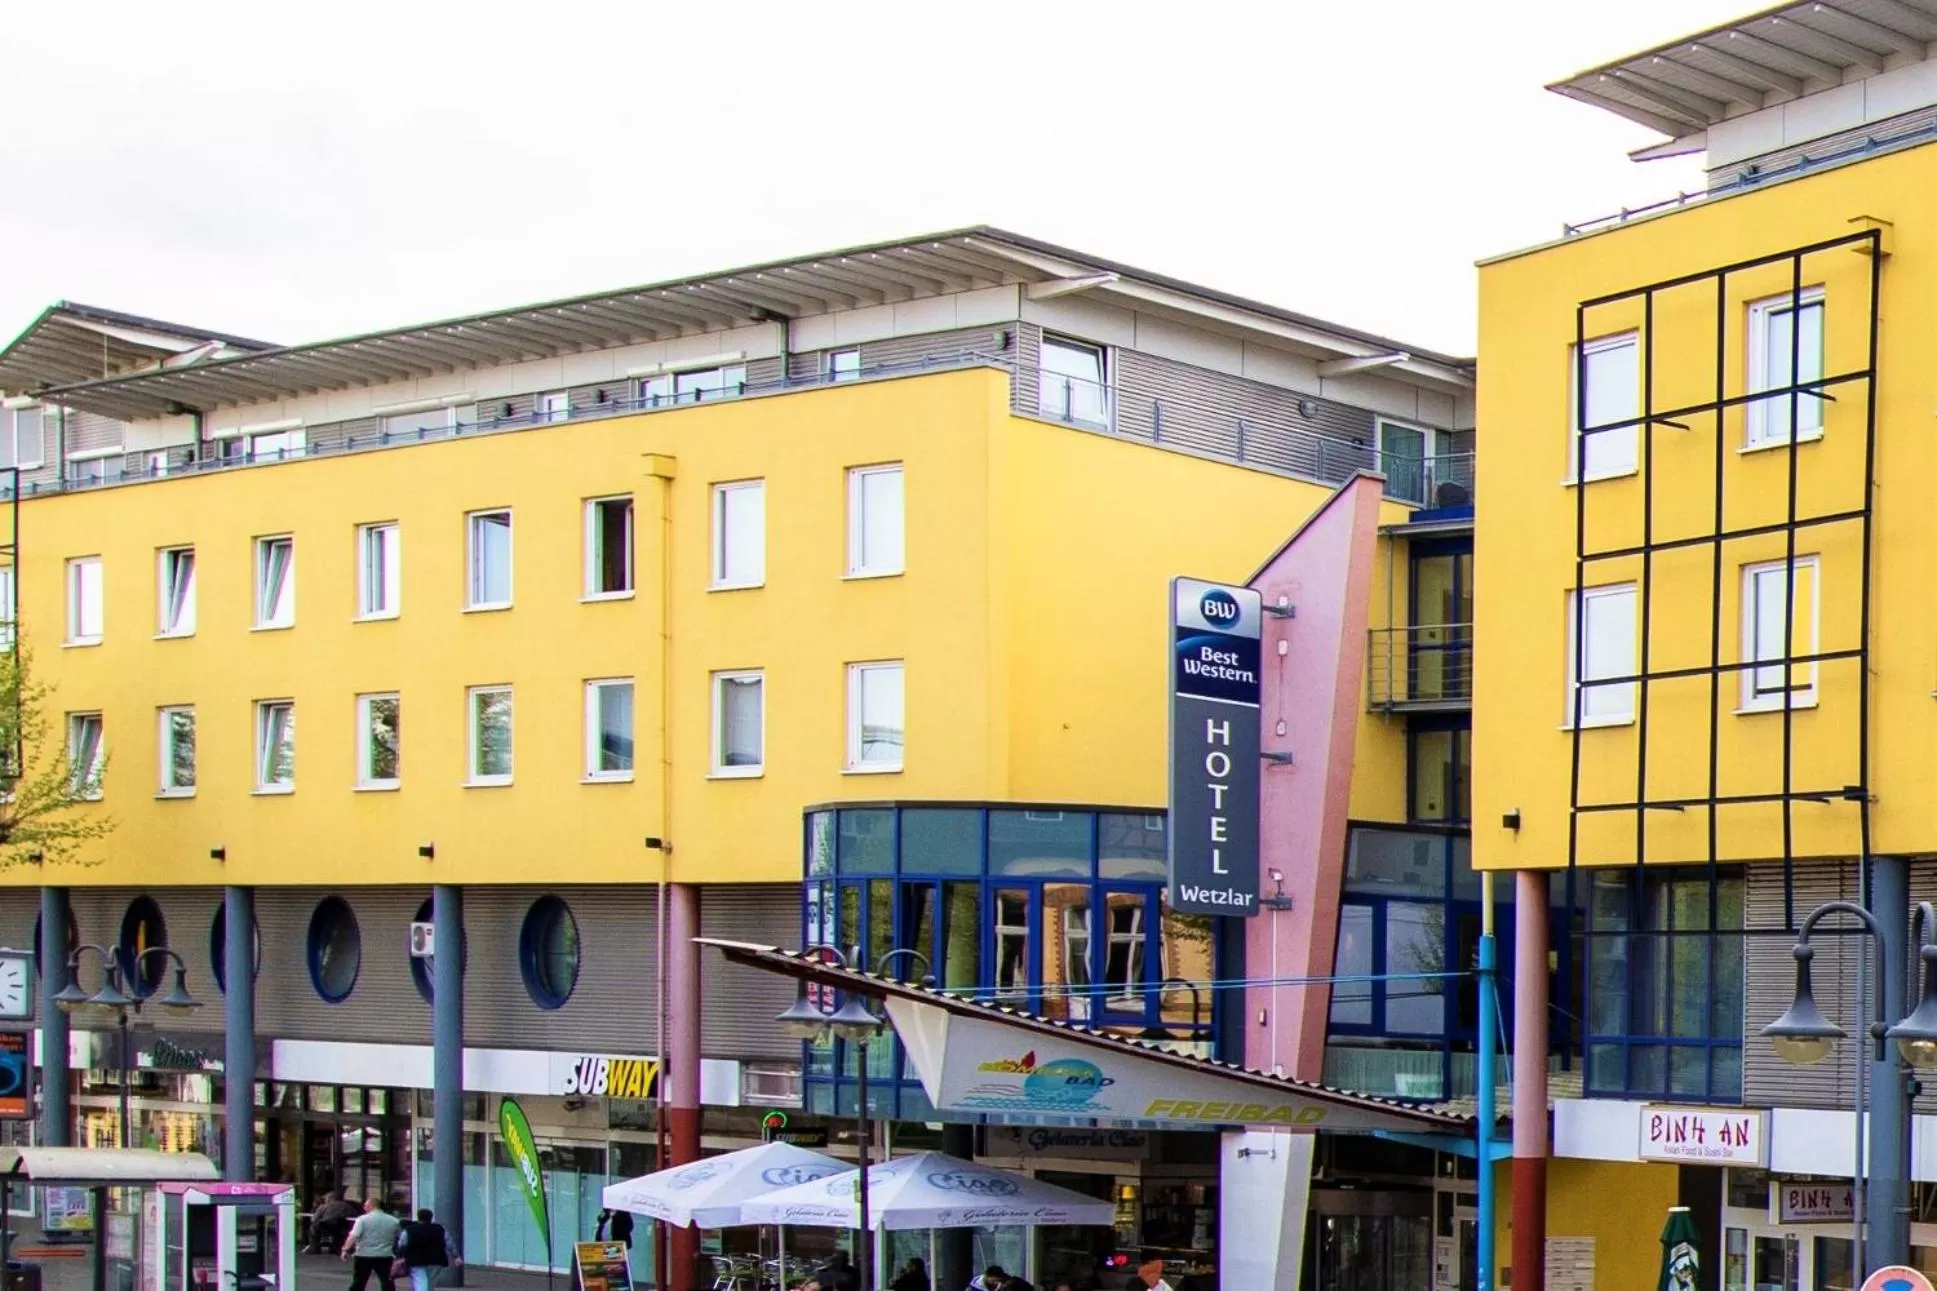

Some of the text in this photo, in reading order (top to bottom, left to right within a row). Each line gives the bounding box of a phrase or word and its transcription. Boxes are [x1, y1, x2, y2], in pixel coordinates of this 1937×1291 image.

[1204, 599, 1236, 619] BW
[1201, 646, 1239, 666] Best
[1183, 658, 1254, 684] Western
[1205, 718, 1231, 875] HOTEL
[1180, 885, 1253, 906] Wetzlar
[564, 1056, 660, 1099] SUBWAY
[1064, 1076, 1115, 1086] BAD
[1144, 1099, 1328, 1124] FREIBAD
[1651, 1114, 1749, 1147] BINH AN
[1789, 1189, 1832, 1209] BINH
